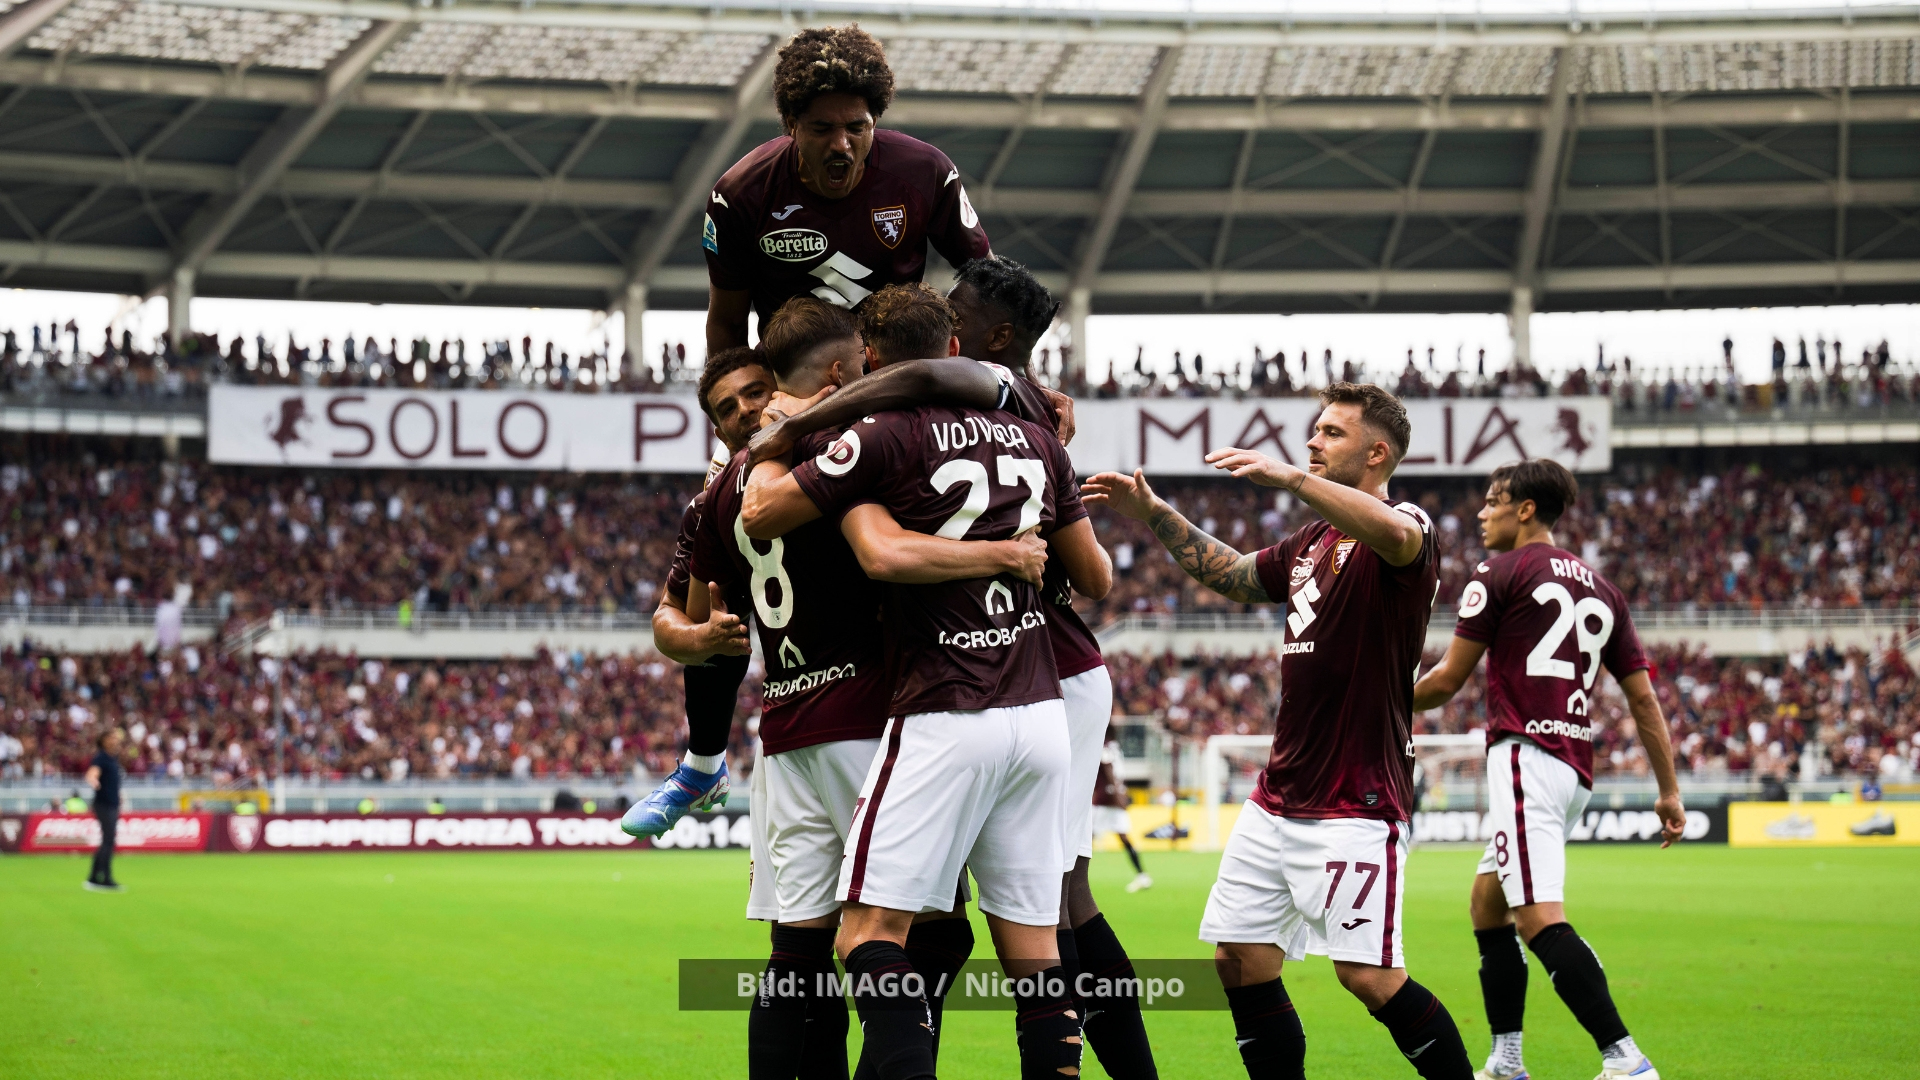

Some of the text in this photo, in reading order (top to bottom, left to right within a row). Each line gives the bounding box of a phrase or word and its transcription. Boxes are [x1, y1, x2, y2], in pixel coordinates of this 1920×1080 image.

[875, 211, 901, 220] TORINO
[763, 235, 825, 253] Beretta
[326, 396, 549, 460] SOLO
[1138, 405, 1528, 465] MAIA
[930, 455, 1046, 541] 27
[733, 511, 794, 629] 8
[1550, 558, 1595, 590] RICCI
[264, 818, 413, 847] SEMPRE
[414, 818, 534, 846] FORZA
[1325, 861, 1380, 910] 77
